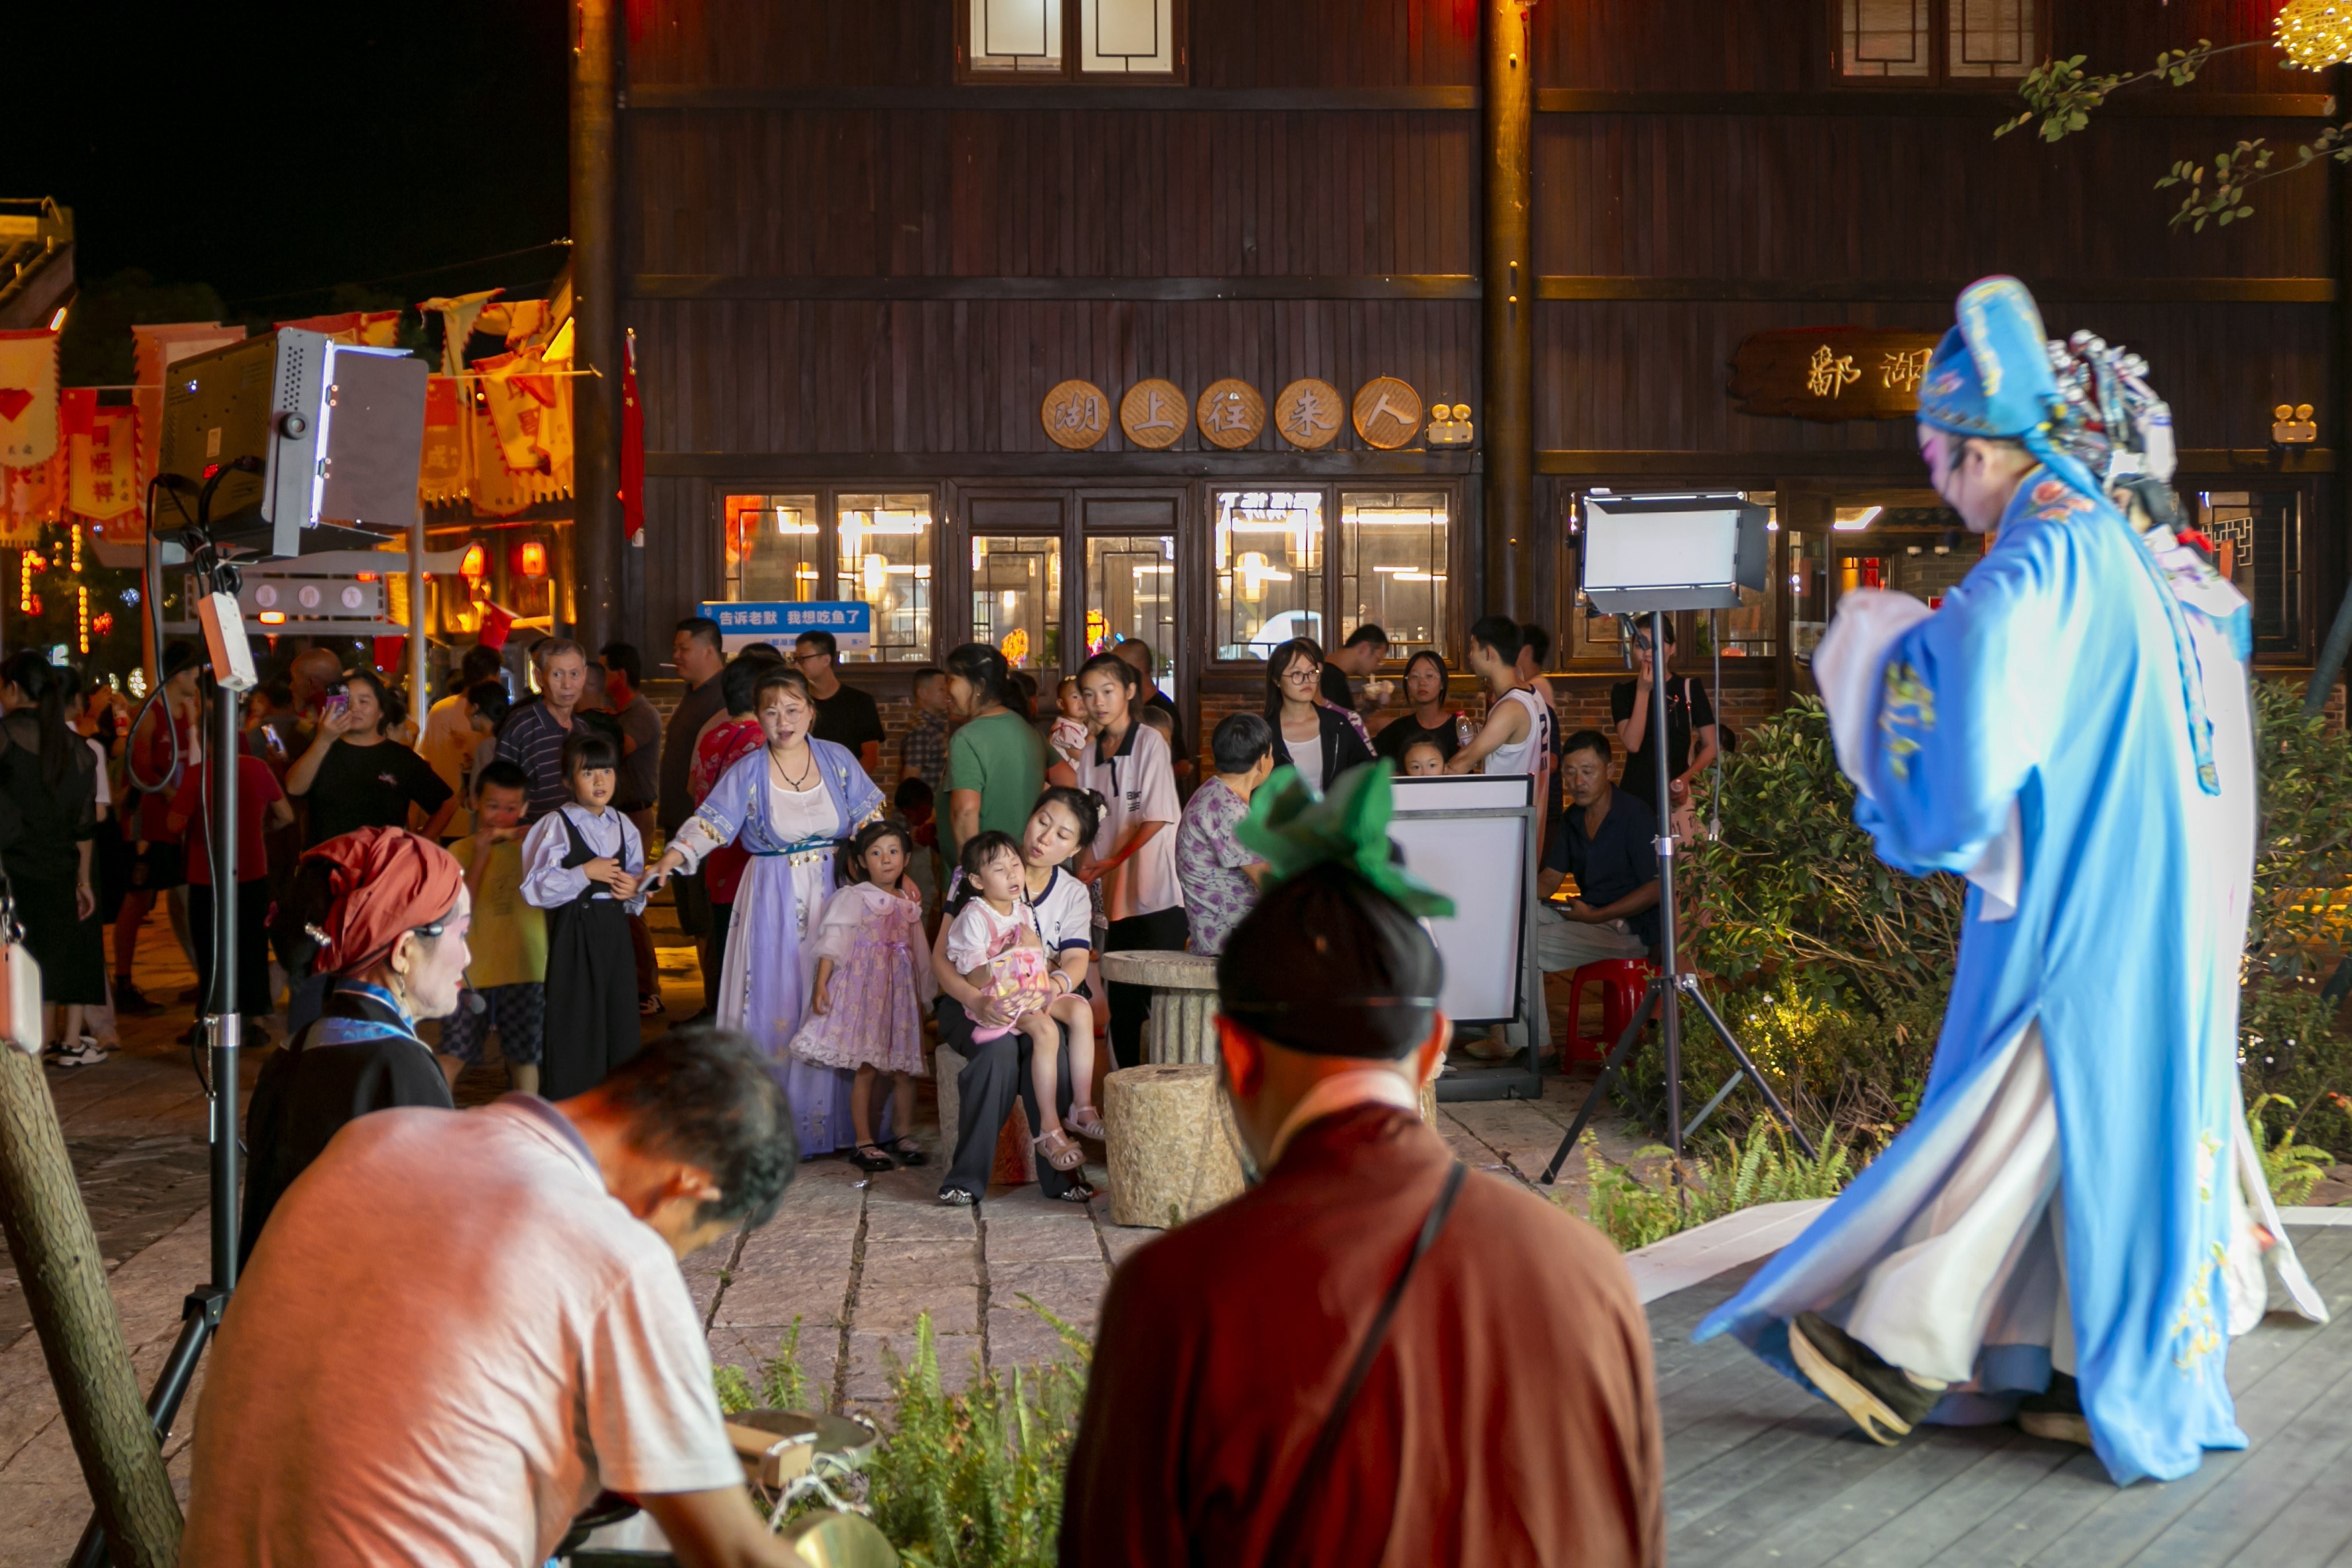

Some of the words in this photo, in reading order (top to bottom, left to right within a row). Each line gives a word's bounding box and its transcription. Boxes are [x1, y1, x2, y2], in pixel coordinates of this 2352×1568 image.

[1055, 389, 1416, 438] 湖上往来人
[719, 610, 778, 626] 告诉老默
[787, 609, 860, 625] 我想吃鱼了
